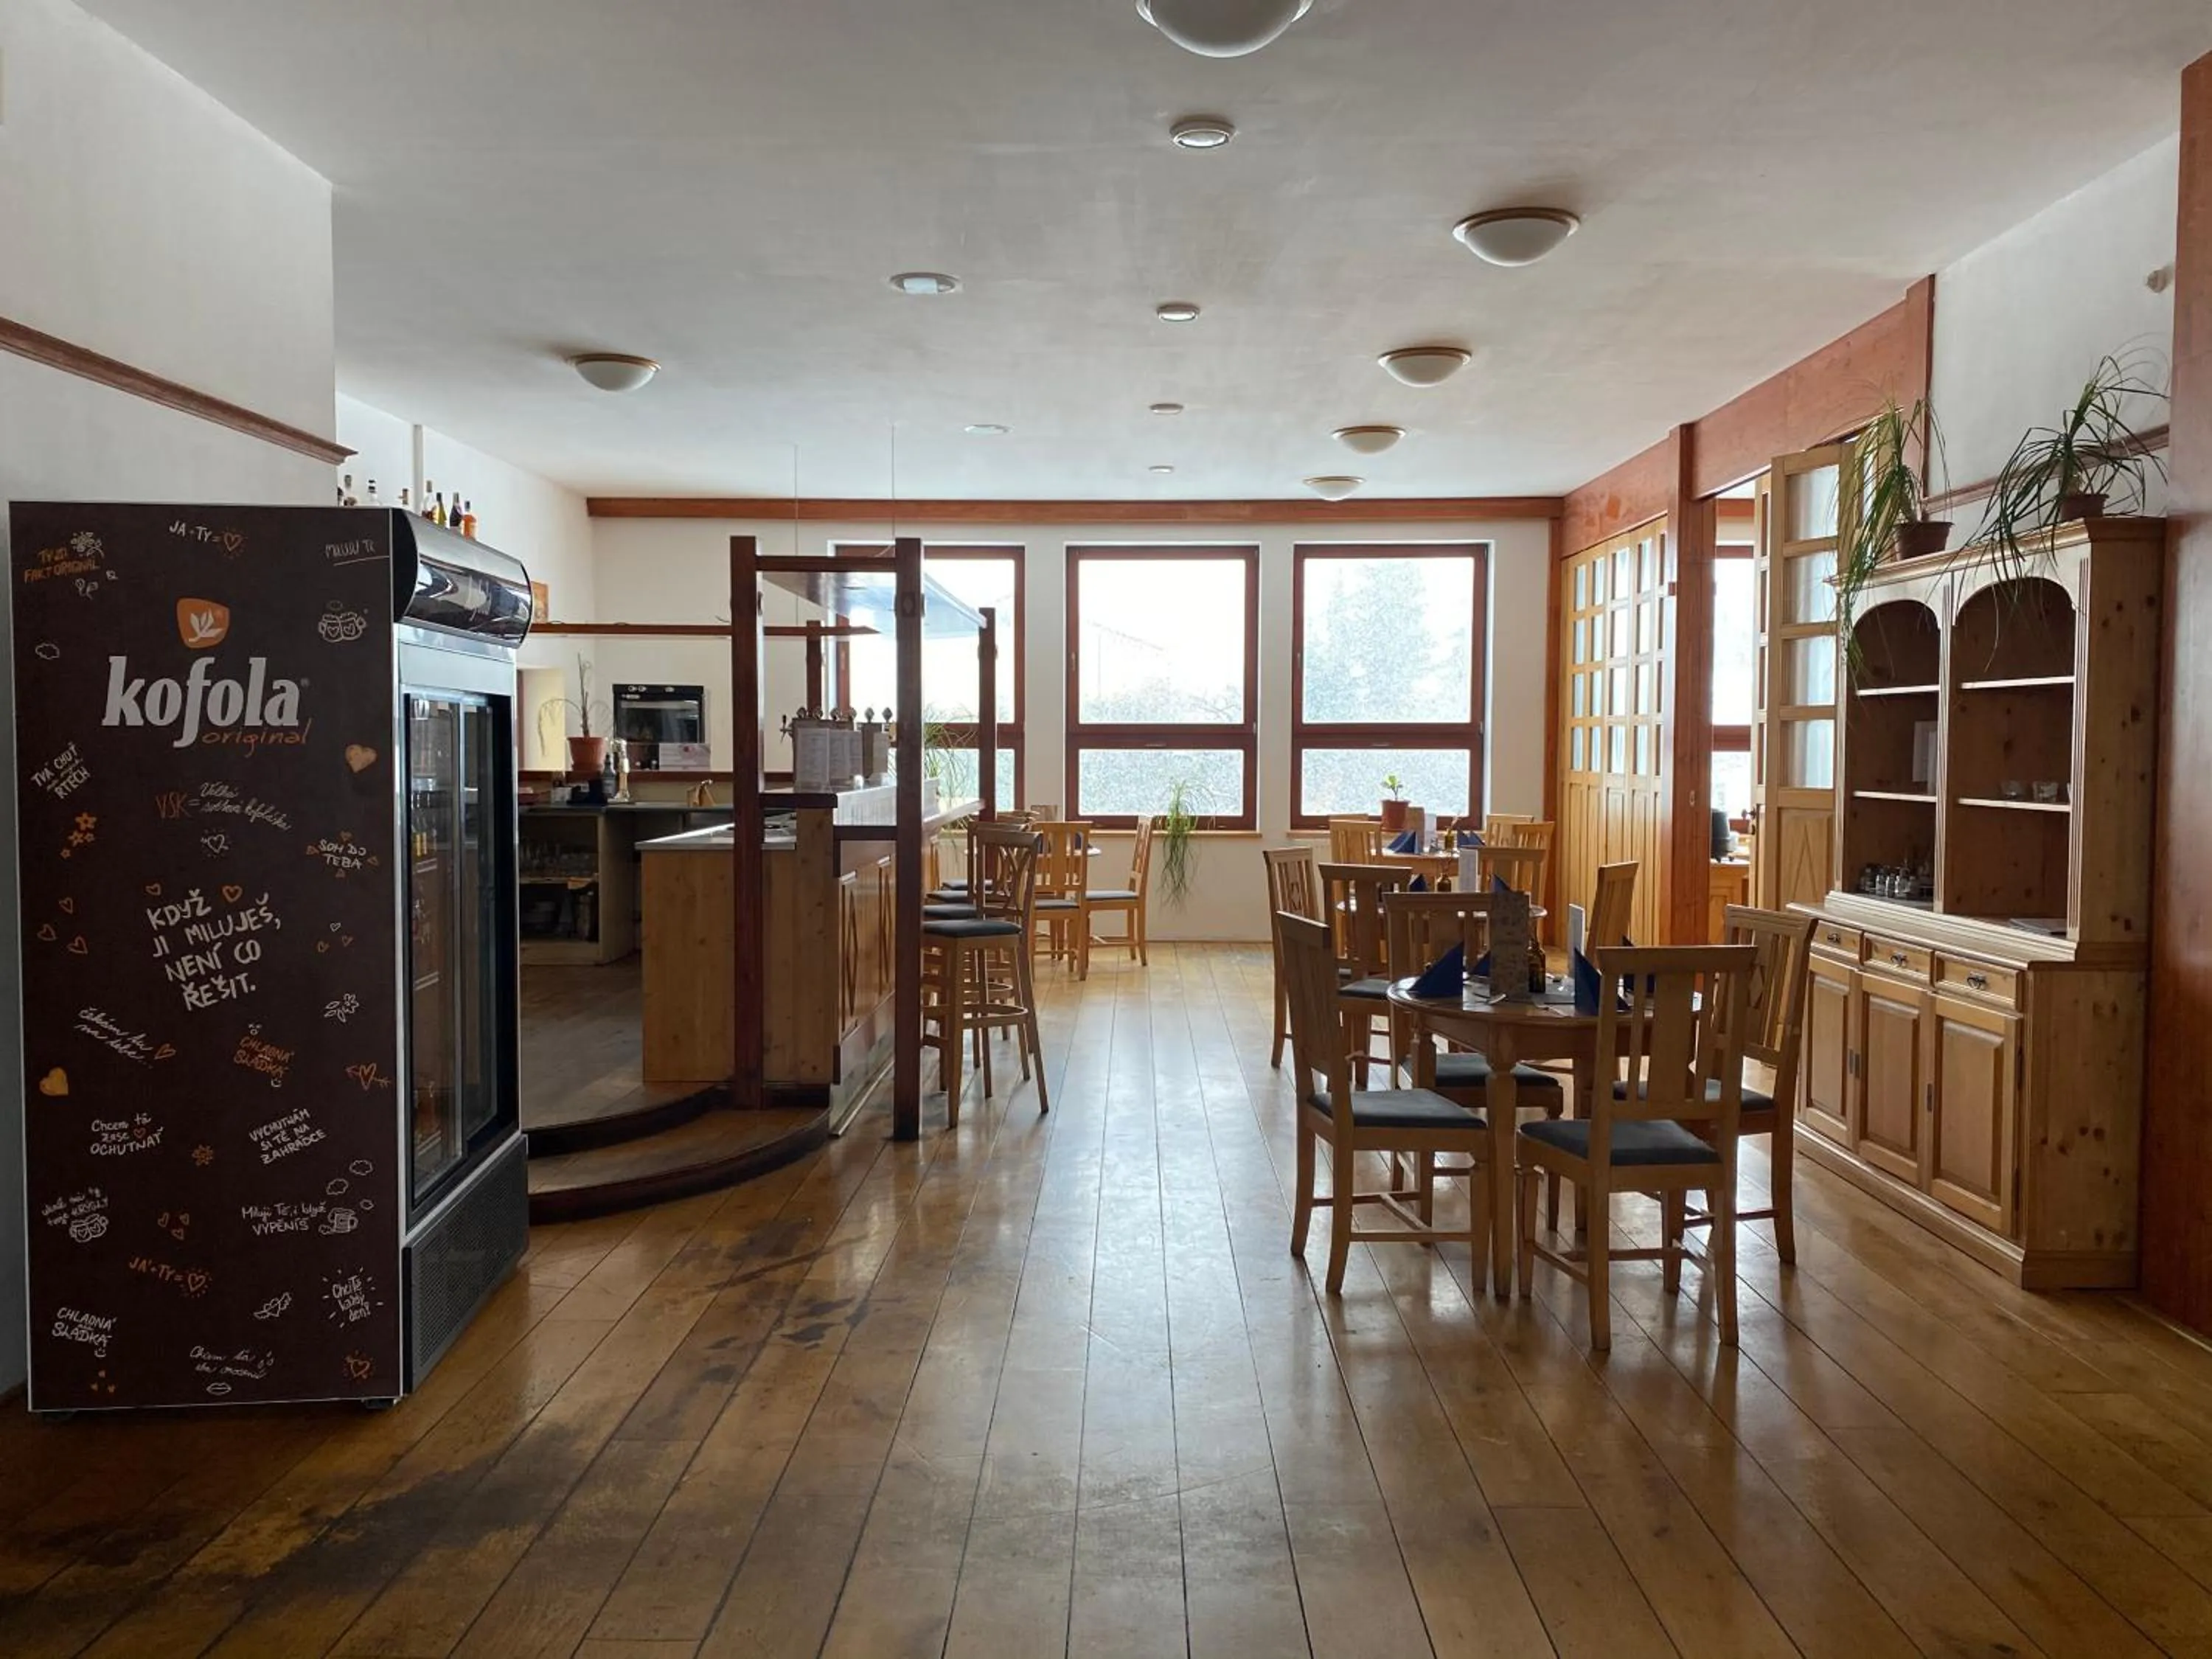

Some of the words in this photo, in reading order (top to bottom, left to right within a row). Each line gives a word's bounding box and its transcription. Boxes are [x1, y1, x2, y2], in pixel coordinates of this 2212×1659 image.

[101, 655, 300, 748] kofola
[201, 716, 313, 758] original
[321, 853, 364, 869] TEBA
[147, 888, 212, 931] KDYŽ
[153, 935, 170, 958] JI
[164, 942, 223, 983] NENÍ
[234, 939, 262, 965] CO
